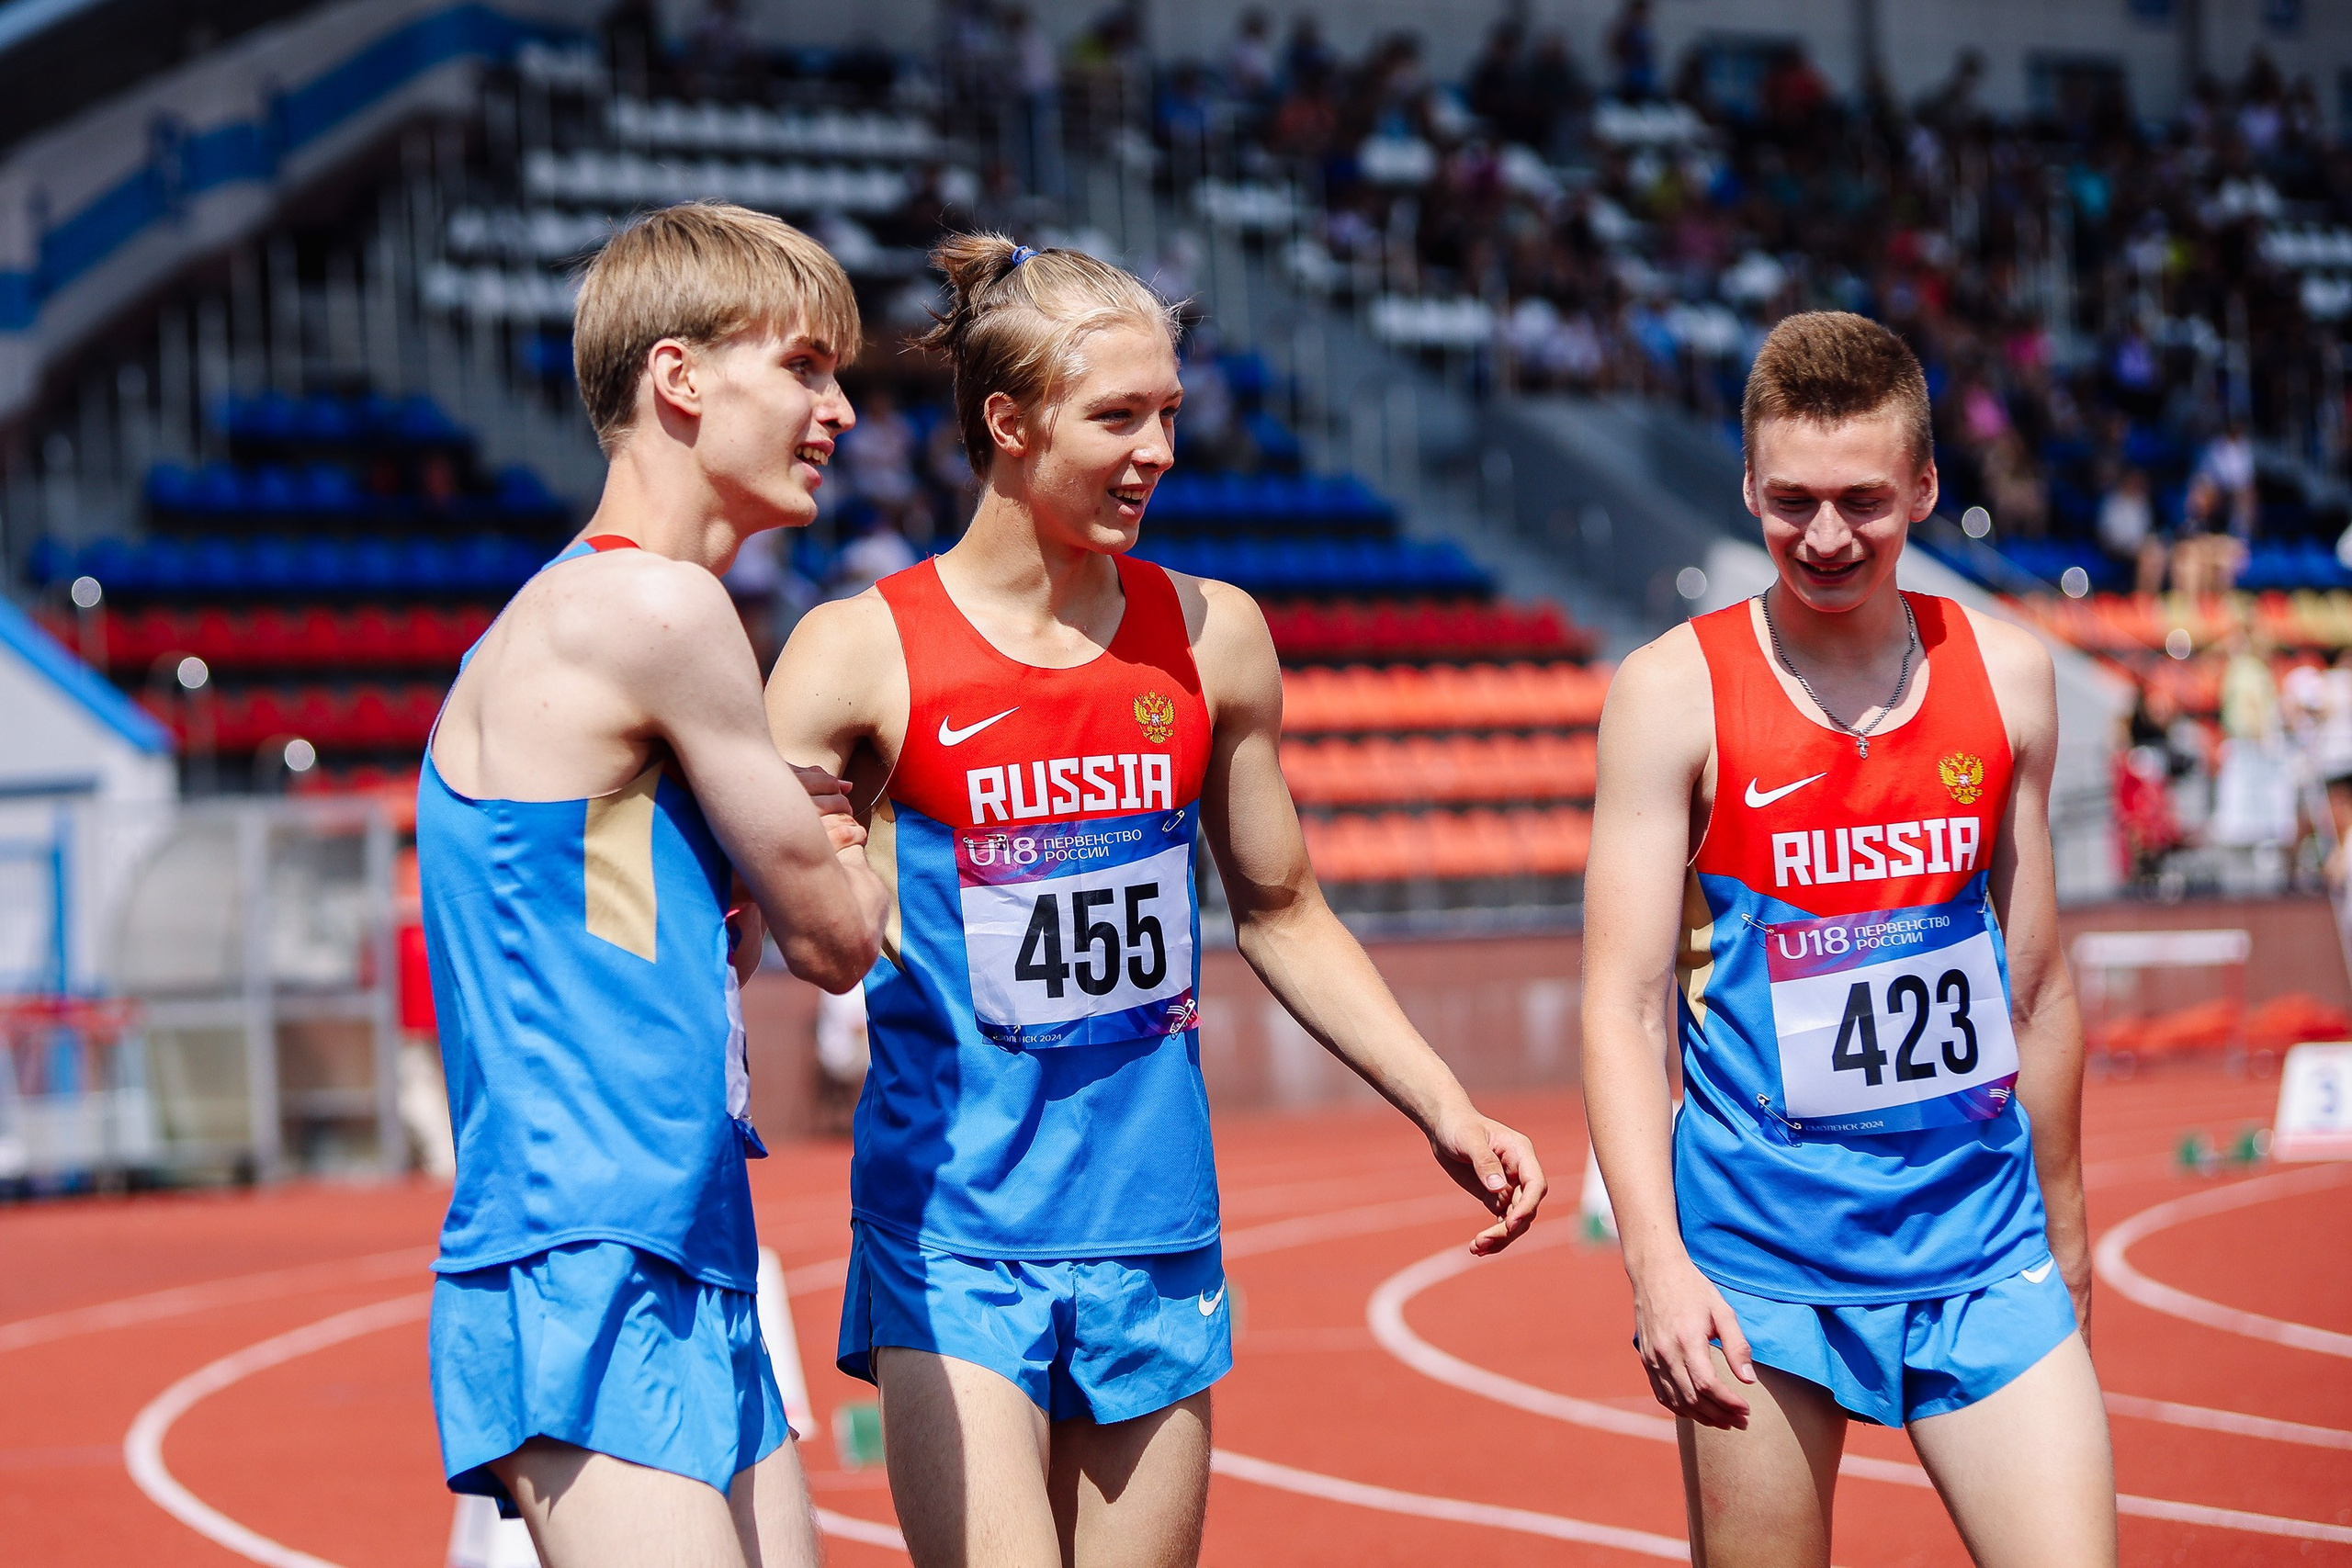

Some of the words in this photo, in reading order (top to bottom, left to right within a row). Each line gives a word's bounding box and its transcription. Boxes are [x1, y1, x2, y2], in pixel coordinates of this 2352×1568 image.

[966, 753, 1173, 825] RUSSIA
[1043, 829, 1143, 851] ПЕРВЕНСТВО
[1771, 817, 1981, 887] RUSSIA
[1045, 845, 1110, 863] РОССИИ
[1853, 915, 1951, 939] ПЕРВЕНСТВО
[1014, 881, 1168, 999] 455
[1778, 926, 1850, 960] U18
[1856, 931, 1924, 951] РОССИИ
[1039, 1033, 1062, 1043] 2024
[1831, 967, 1979, 1088] 423
[1860, 1120, 1884, 1130] 2024
